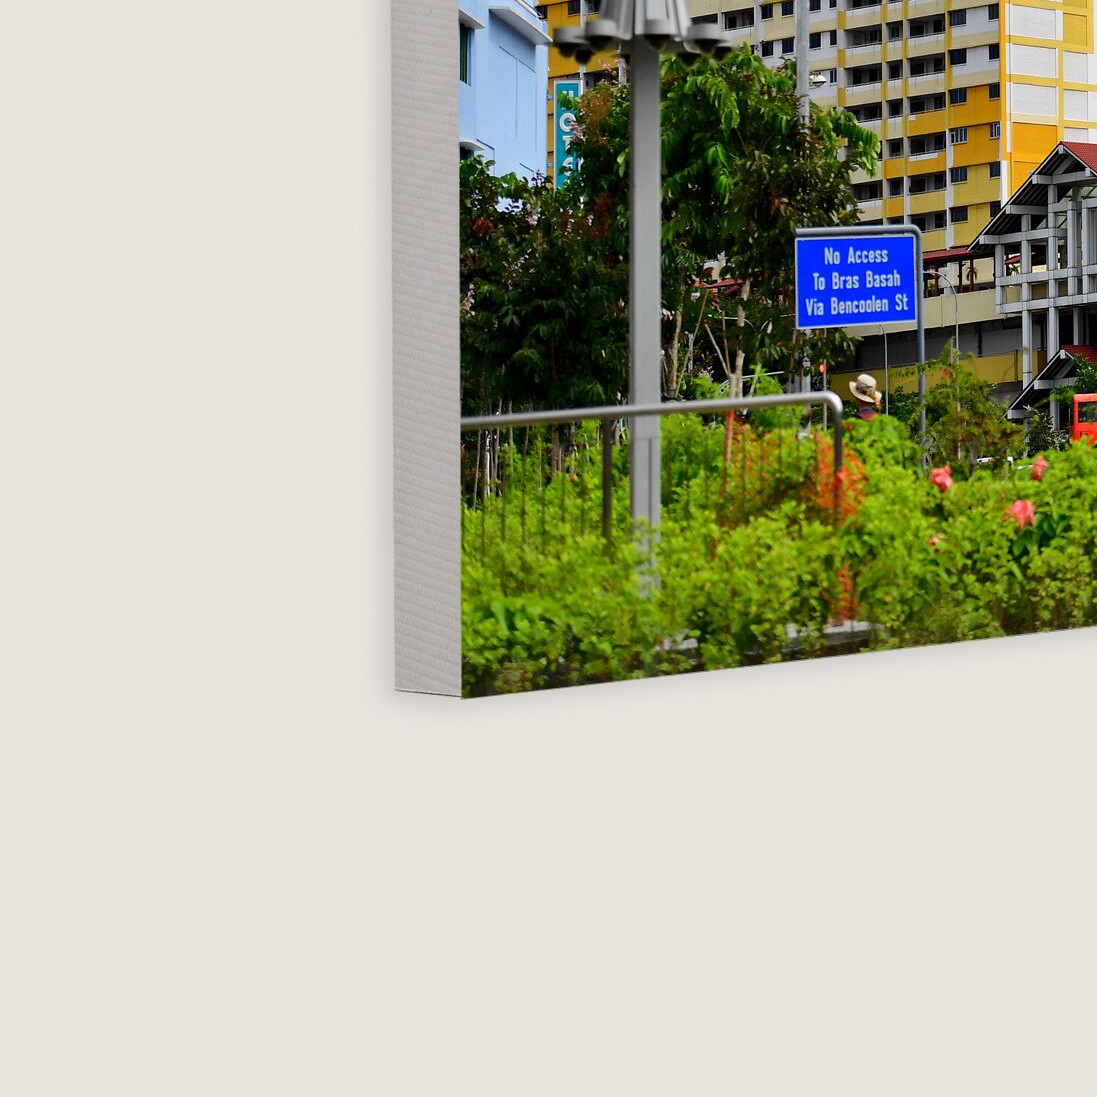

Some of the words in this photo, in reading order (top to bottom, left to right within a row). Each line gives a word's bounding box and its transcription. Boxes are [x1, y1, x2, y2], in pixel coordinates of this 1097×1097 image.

[823, 247, 841, 265] No
[847, 246, 888, 264] Access
[812, 272, 825, 291] To
[832, 271, 860, 290] Bras
[866, 269, 901, 288] Basah
[805, 298, 824, 317] Via
[831, 295, 889, 315] Bencoolen
[895, 292, 909, 311] St
